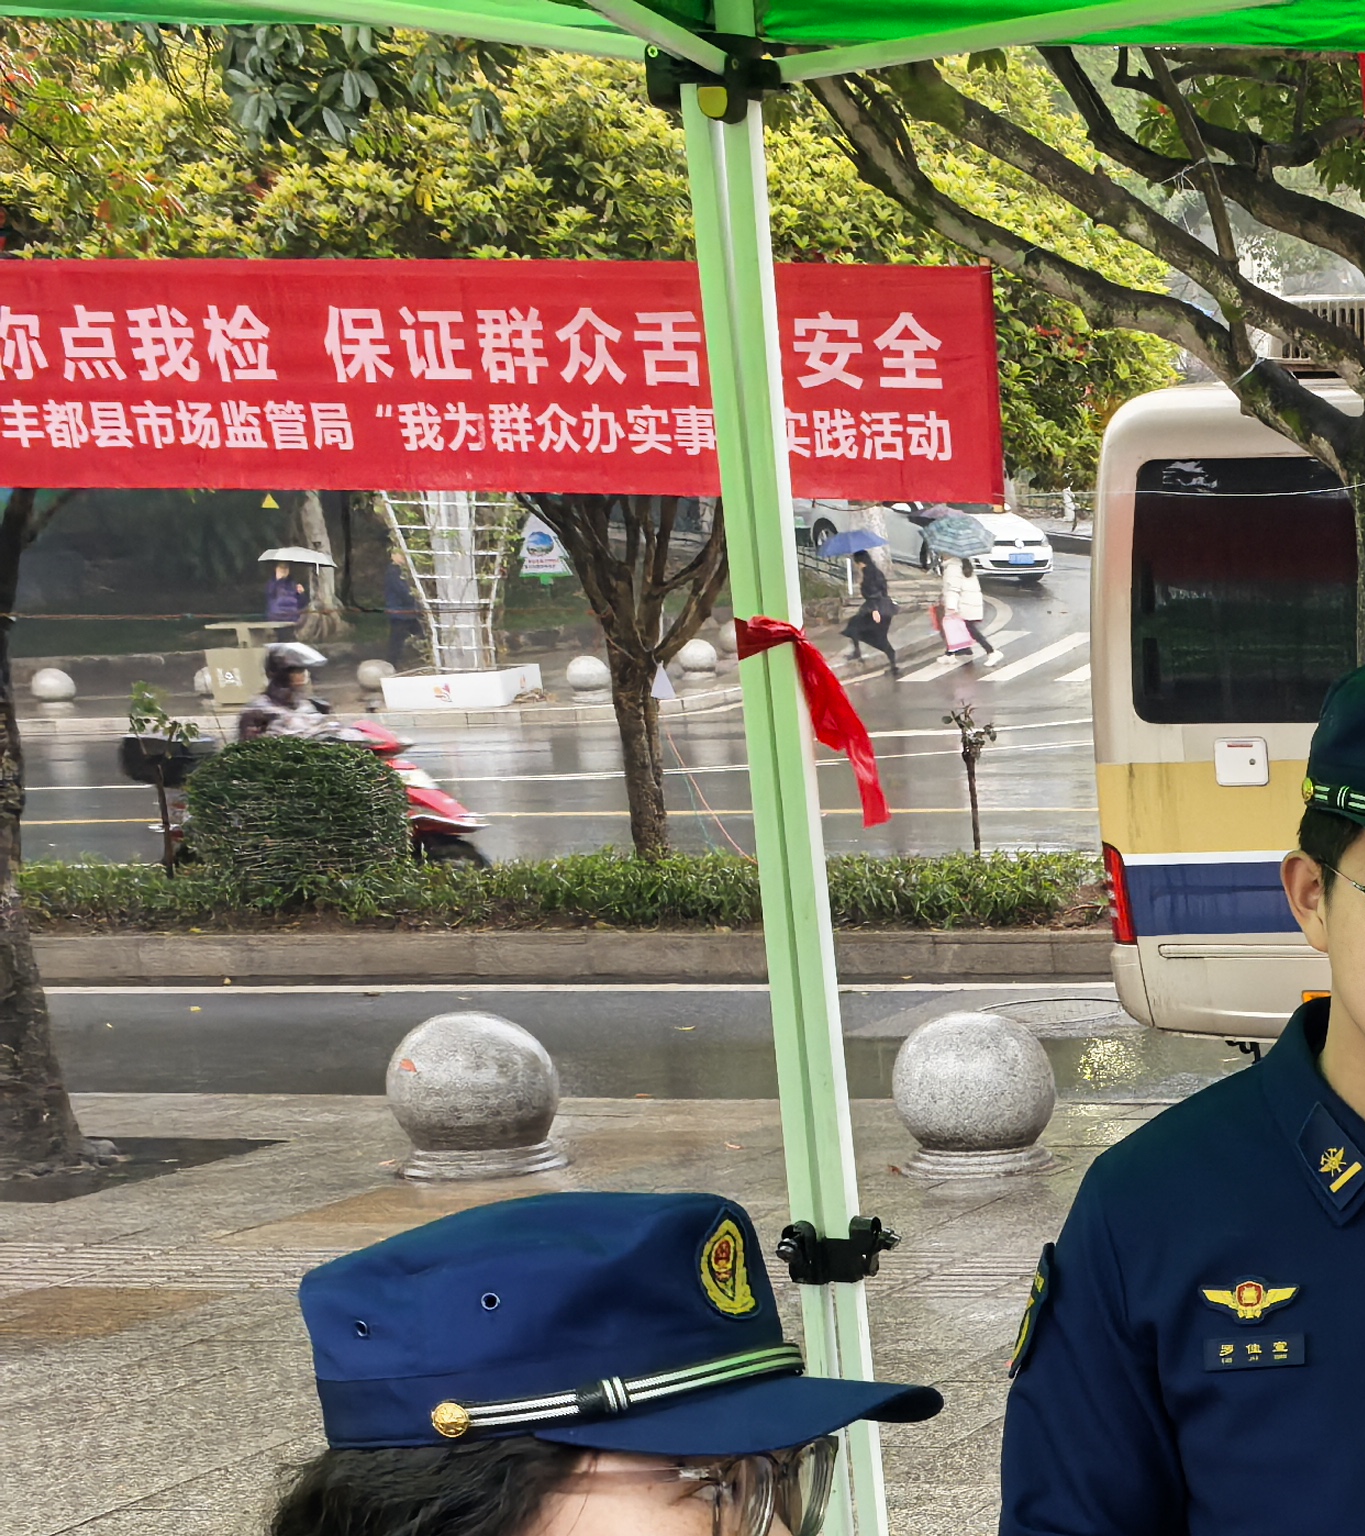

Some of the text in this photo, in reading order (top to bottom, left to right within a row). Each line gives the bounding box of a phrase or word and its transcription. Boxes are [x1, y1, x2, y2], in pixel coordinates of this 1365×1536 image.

[324, 303, 944, 390] 保证群众舌安全
[1, 399, 953, 462] 丰都县市场监管局 “我为群众办实事实践活动
